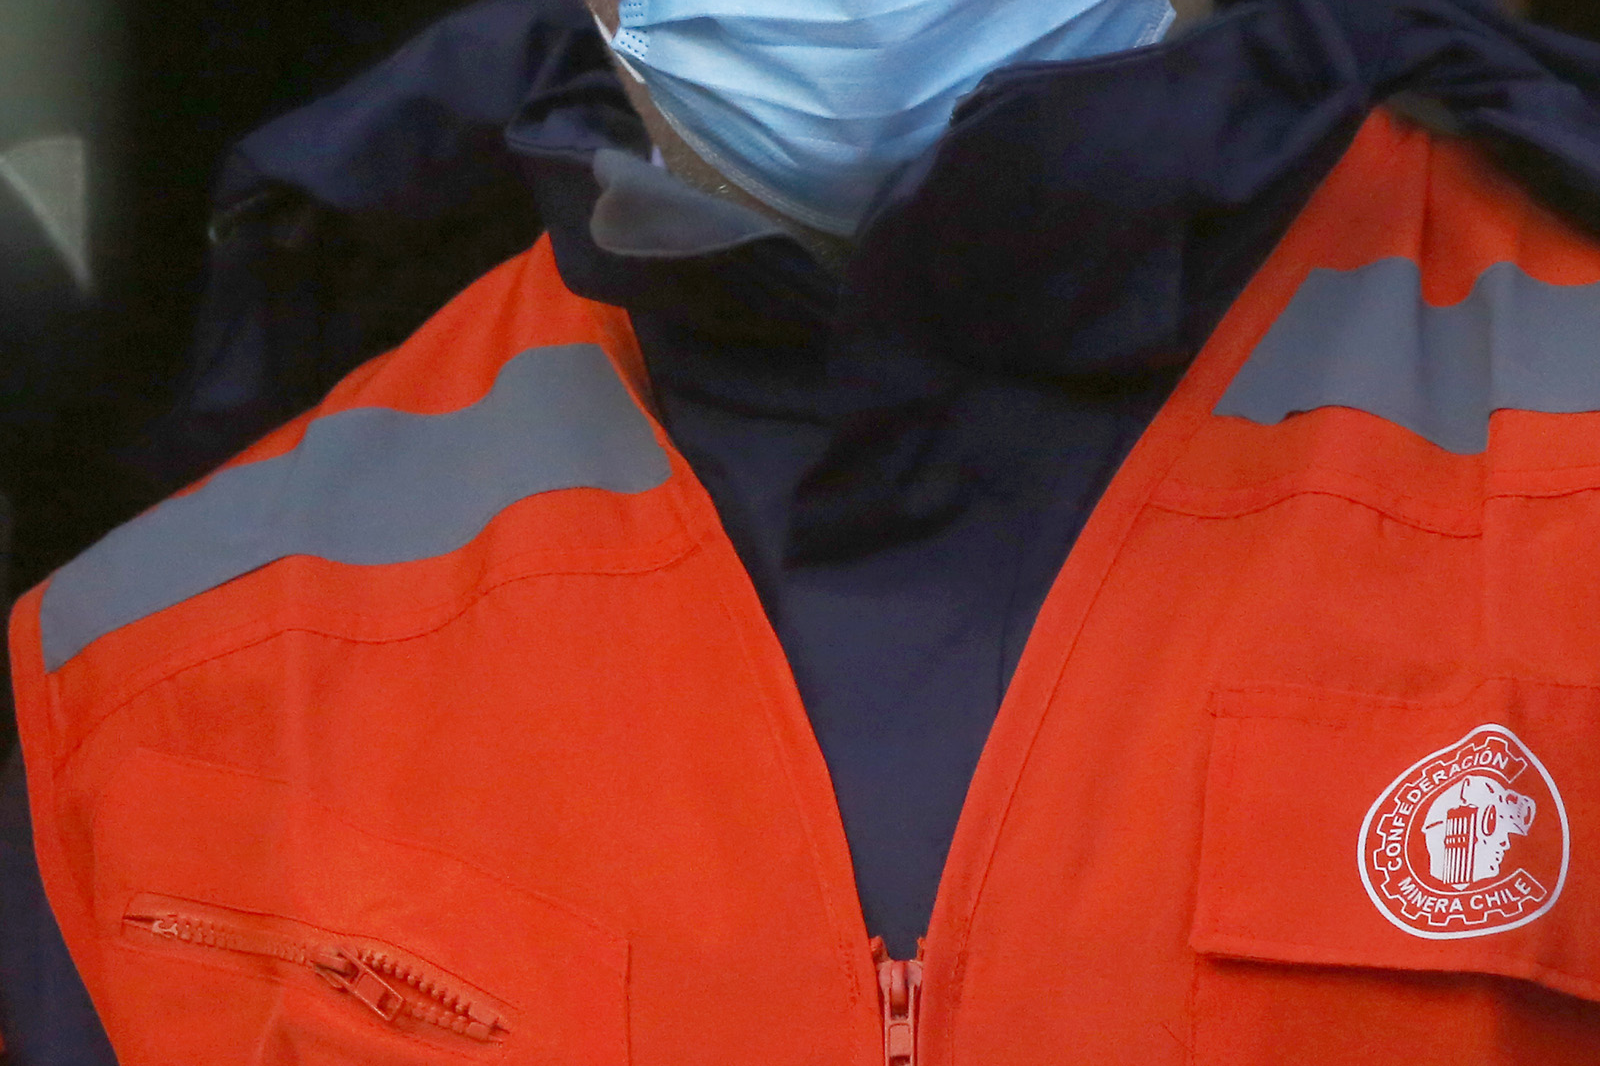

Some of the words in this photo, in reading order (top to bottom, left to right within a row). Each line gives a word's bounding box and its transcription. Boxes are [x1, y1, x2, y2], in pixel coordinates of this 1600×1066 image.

[1385, 746, 1509, 872] CONFEDERACIÓN
[1397, 875, 1464, 913] MINERA
[1469, 877, 1531, 911] CHILE
